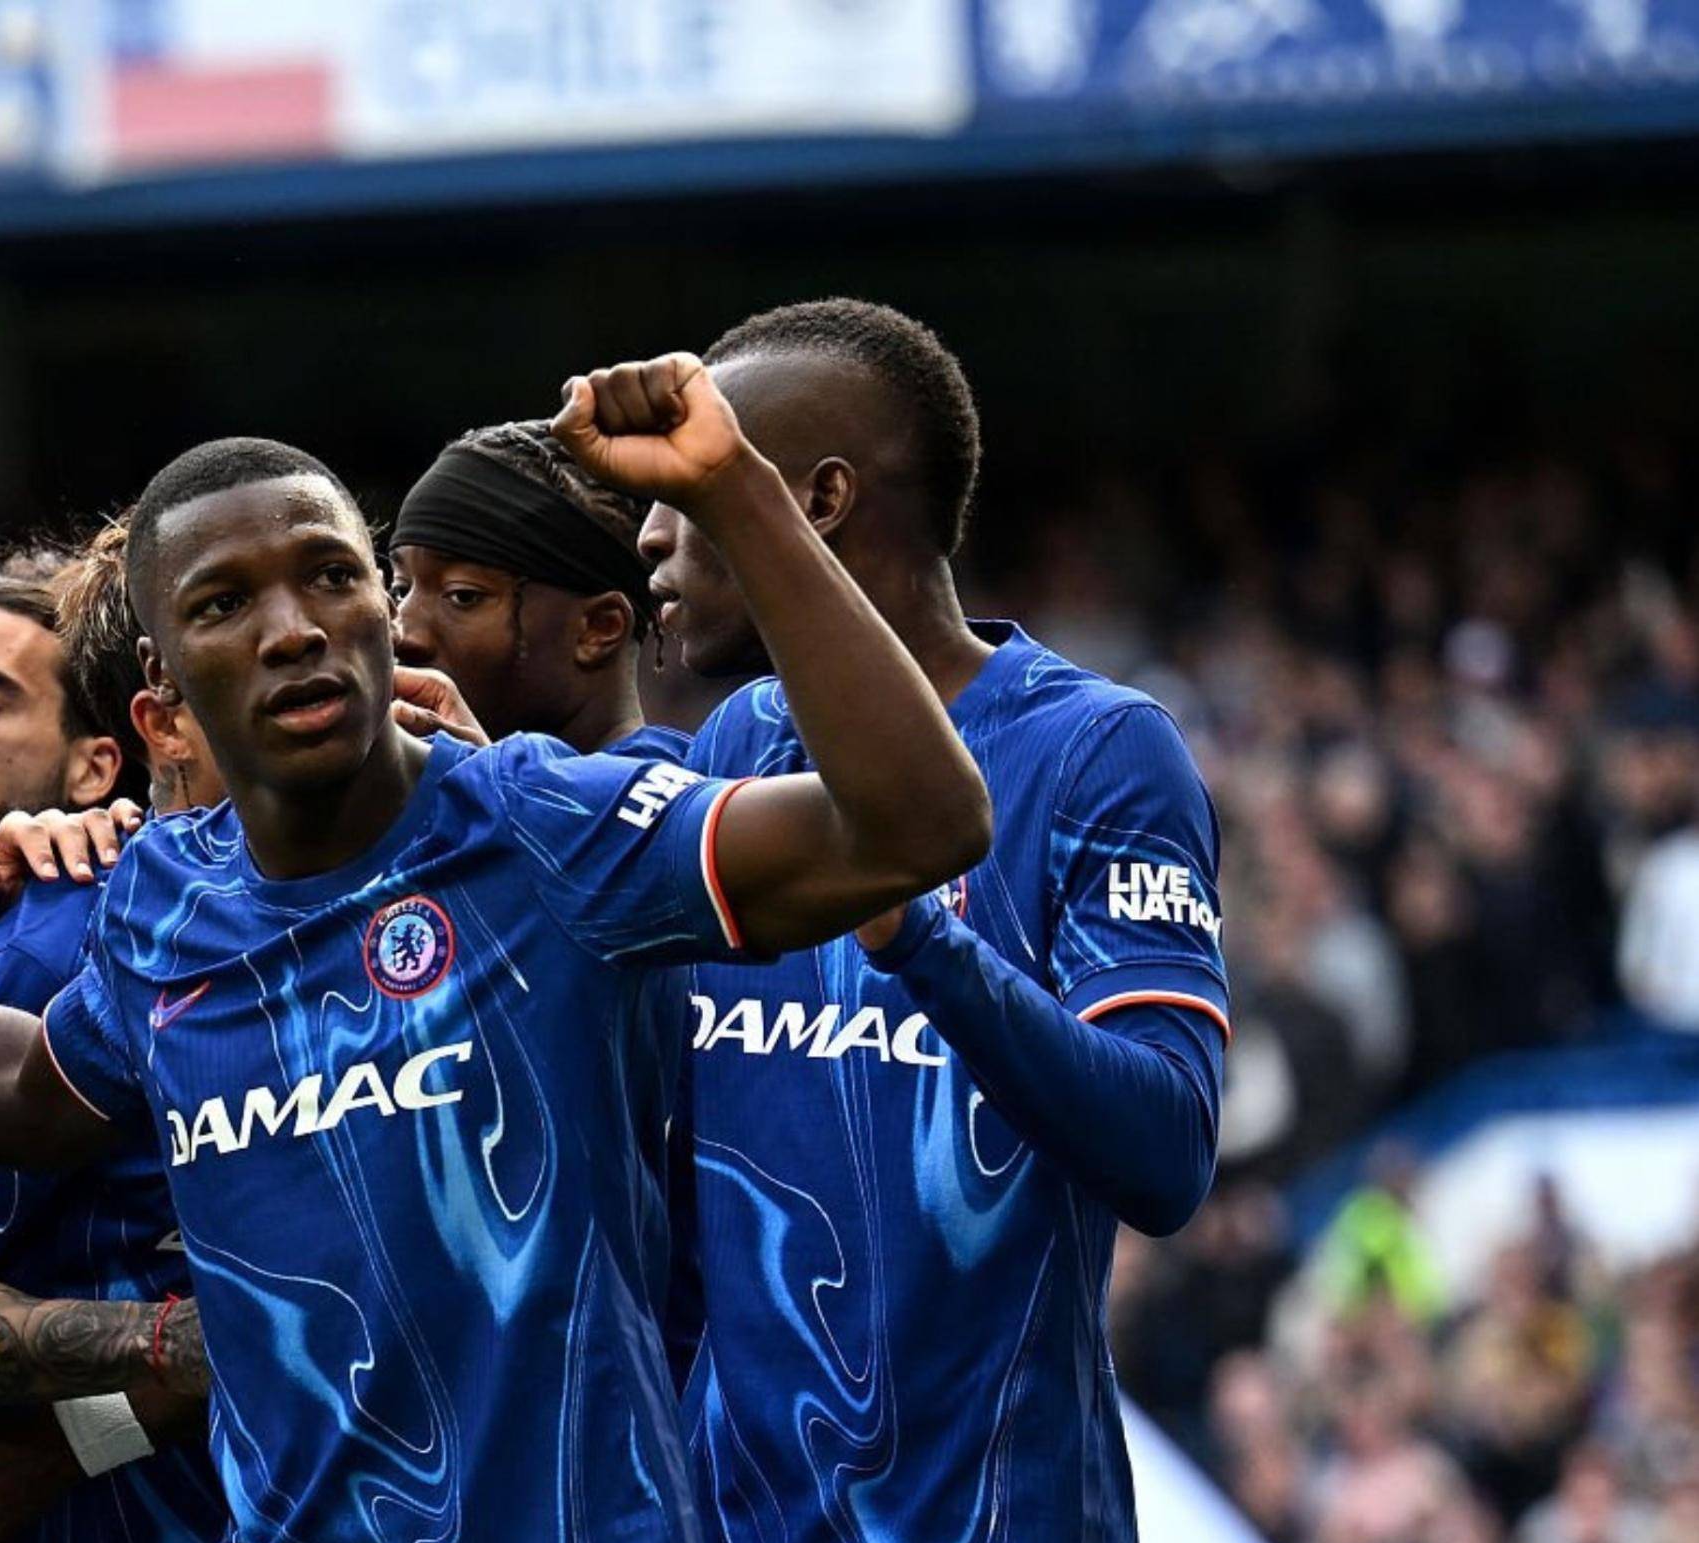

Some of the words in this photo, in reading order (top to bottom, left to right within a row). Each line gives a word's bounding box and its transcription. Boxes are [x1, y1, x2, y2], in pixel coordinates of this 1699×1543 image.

[1109, 863, 1190, 894] LIVE
[1108, 892, 1222, 934] NATIO
[167, 1041, 473, 1167] DAMAC
